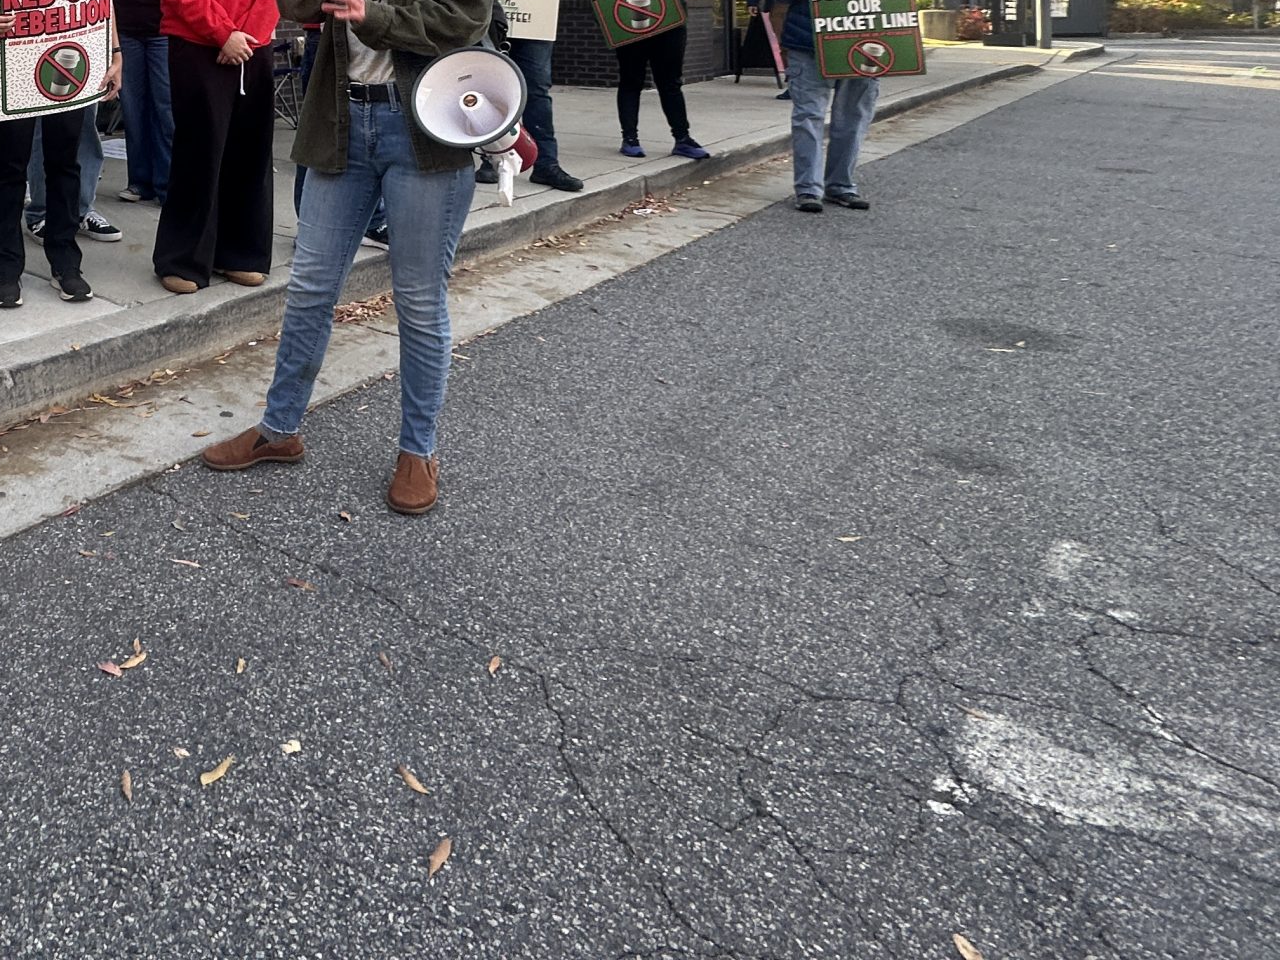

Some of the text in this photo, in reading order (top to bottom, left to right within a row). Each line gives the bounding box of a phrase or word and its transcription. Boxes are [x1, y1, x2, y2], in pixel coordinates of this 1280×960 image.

[814, 11, 919, 33] PICKET LINE
[8, 39, 34, 47] UNFAIR
[35, 36, 58, 44] LABOR
[59, 30, 88, 40] PRACTICE
